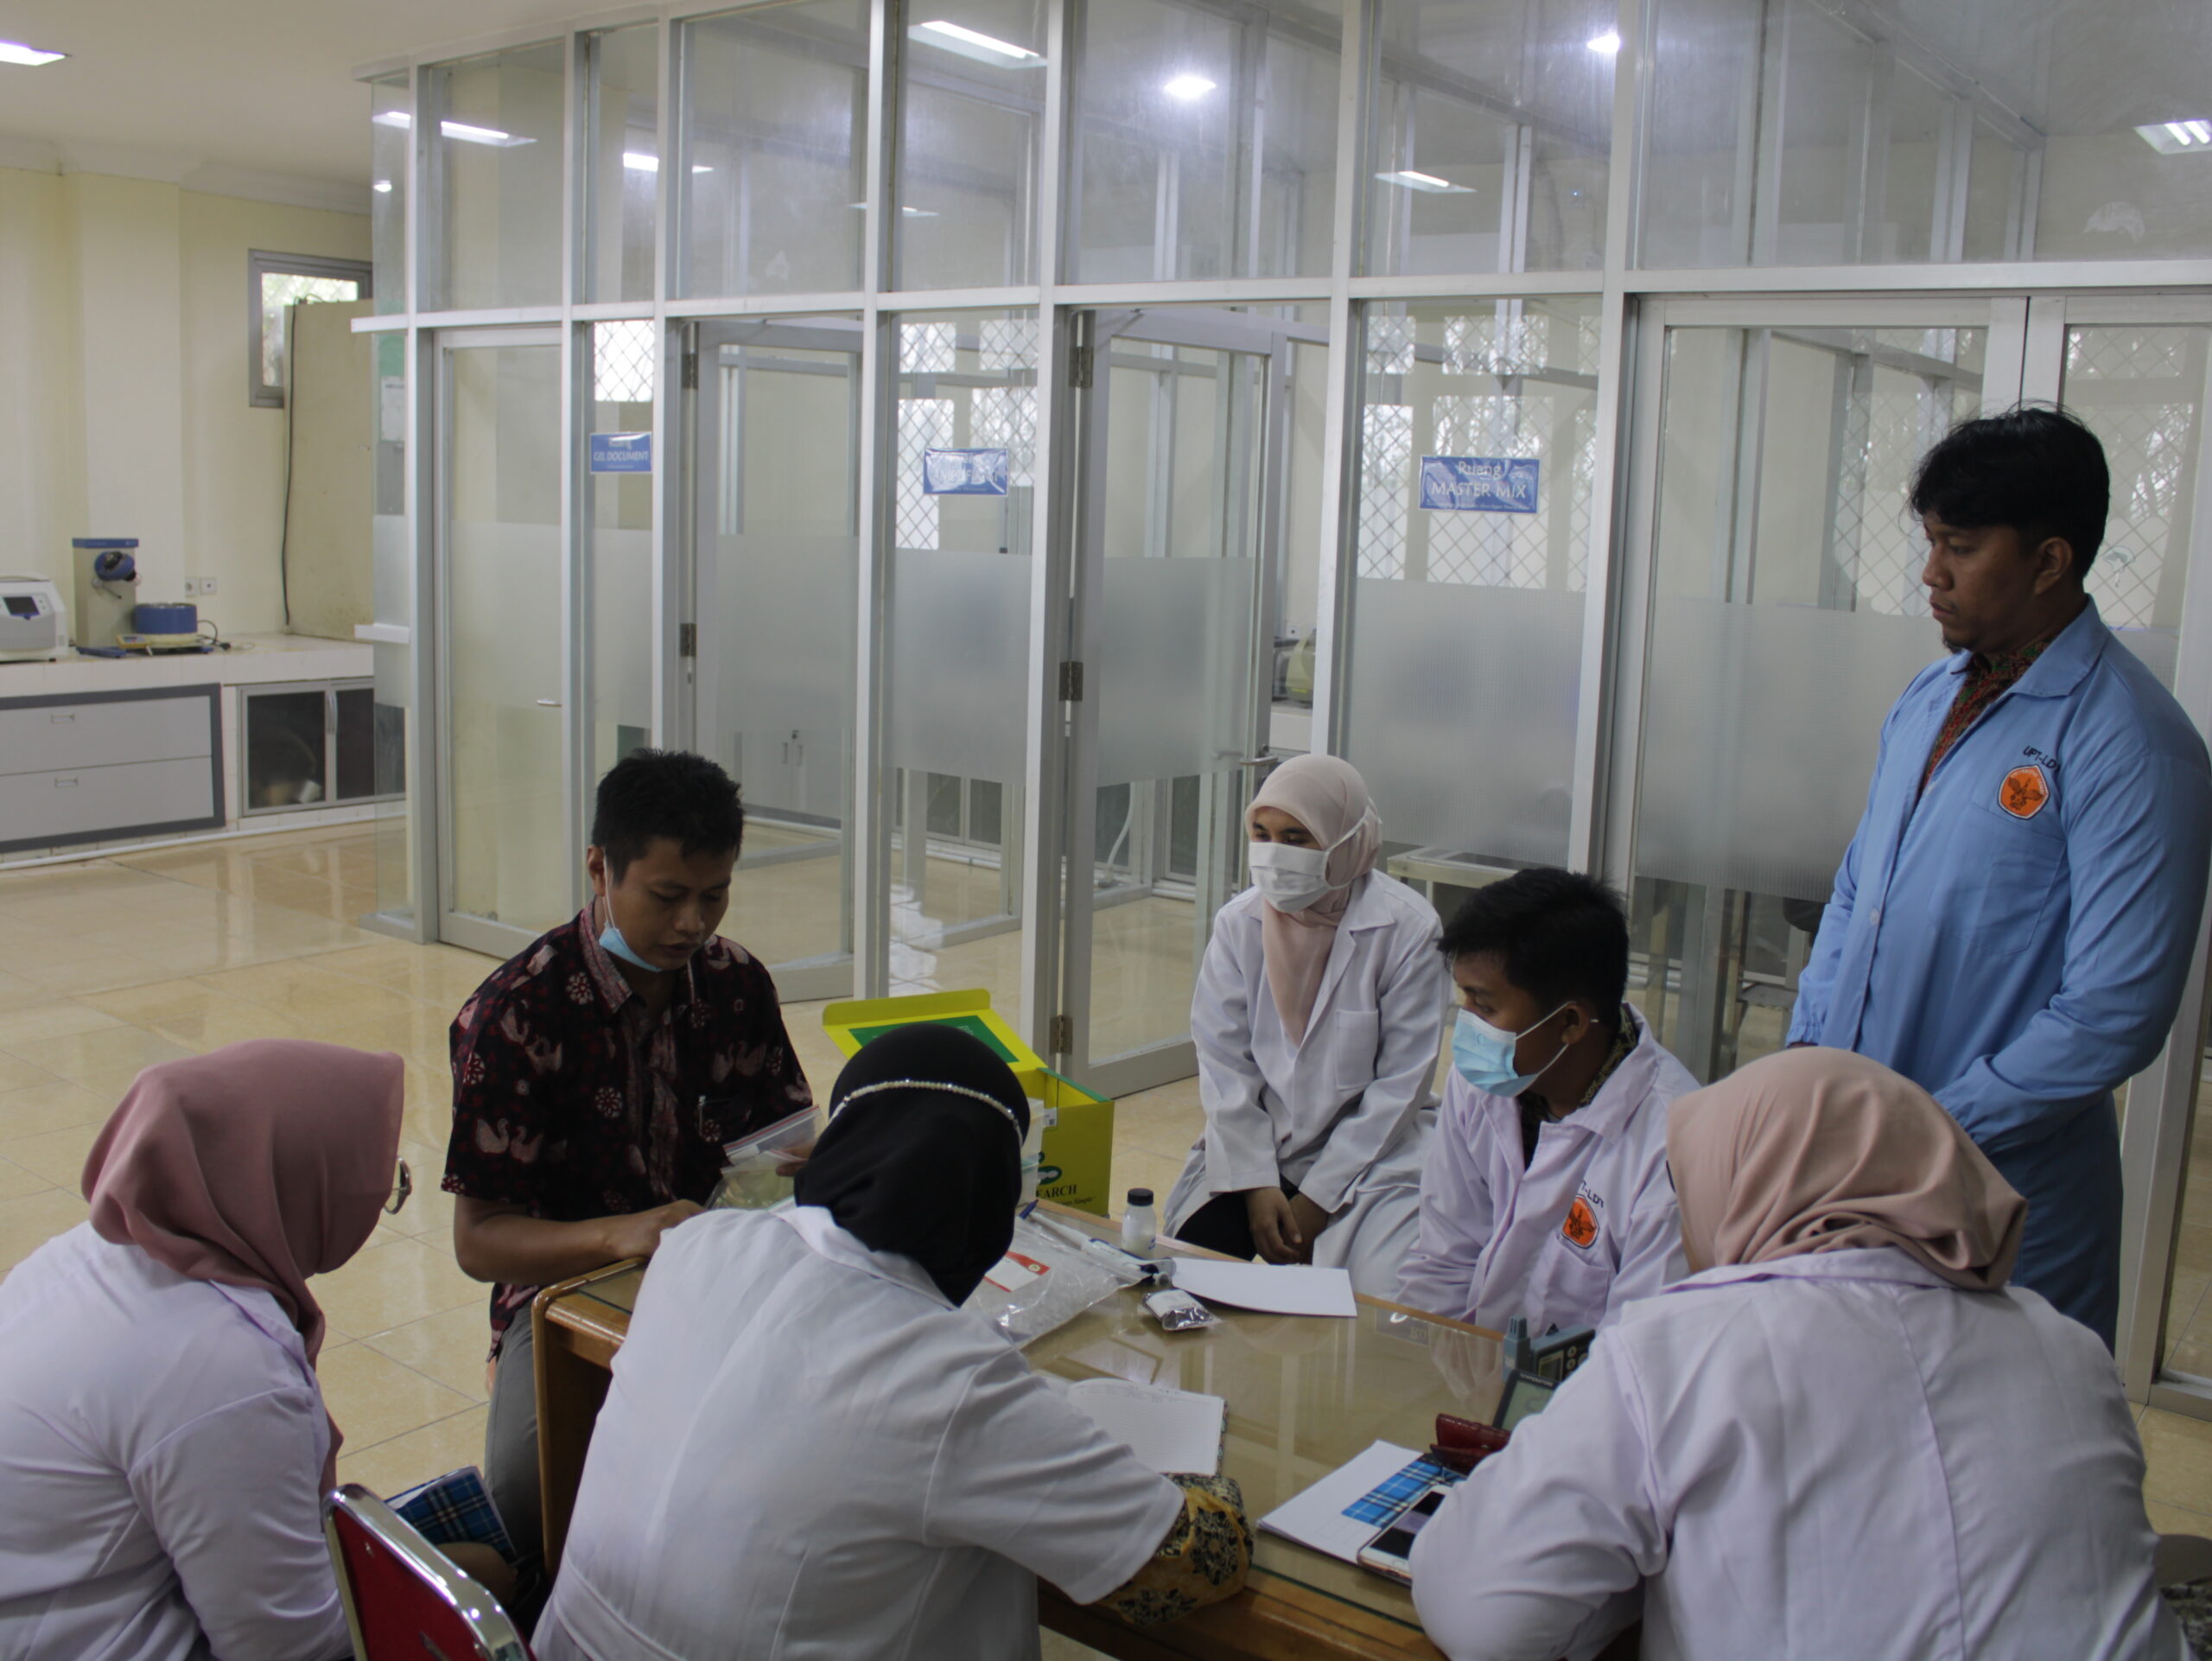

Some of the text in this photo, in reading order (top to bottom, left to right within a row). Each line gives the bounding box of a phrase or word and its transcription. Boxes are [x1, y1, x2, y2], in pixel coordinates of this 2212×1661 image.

[593, 450, 649, 461] GEL DOCUMENT
[1458, 460, 1502, 481] Ruang
[1431, 481, 1528, 499] MASTER MIX
[1036, 1184, 1077, 1199] EARCH
